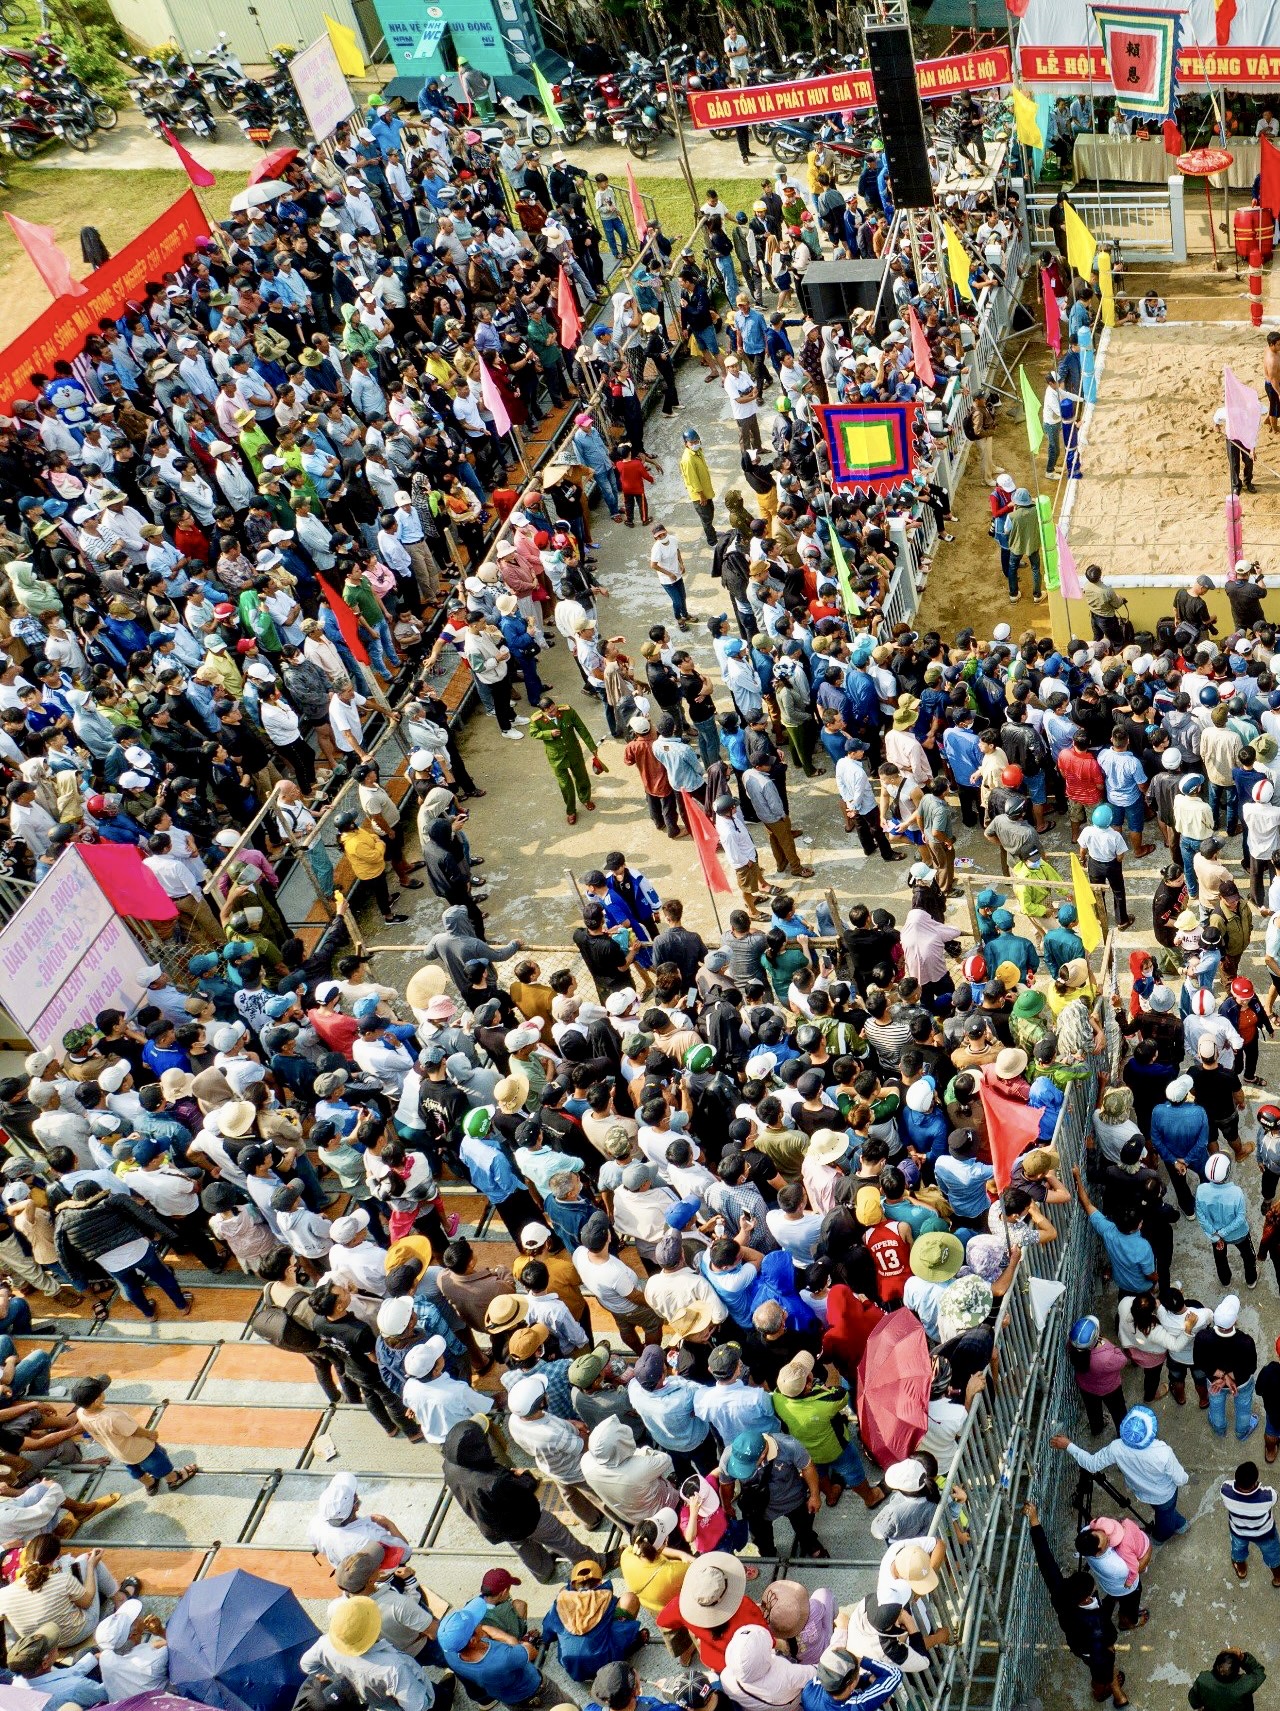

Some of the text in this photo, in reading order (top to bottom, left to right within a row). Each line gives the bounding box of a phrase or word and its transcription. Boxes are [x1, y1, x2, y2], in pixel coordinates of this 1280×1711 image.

[938, 66, 960, 86] HÓA
[961, 61, 977, 84] LỄ
[977, 58, 998, 81] HỘI
[1036, 49, 1060, 75] LỄ
[1065, 53, 1096, 79] HỘI
[1181, 52, 1241, 76] THỐNG
[707, 82, 873, 121] BẢO TỒN VÀ PHÁT HUY GIÁ TRỊ
[87, 288, 117, 321] TRONG
[875, 1248, 901, 1271] 13
